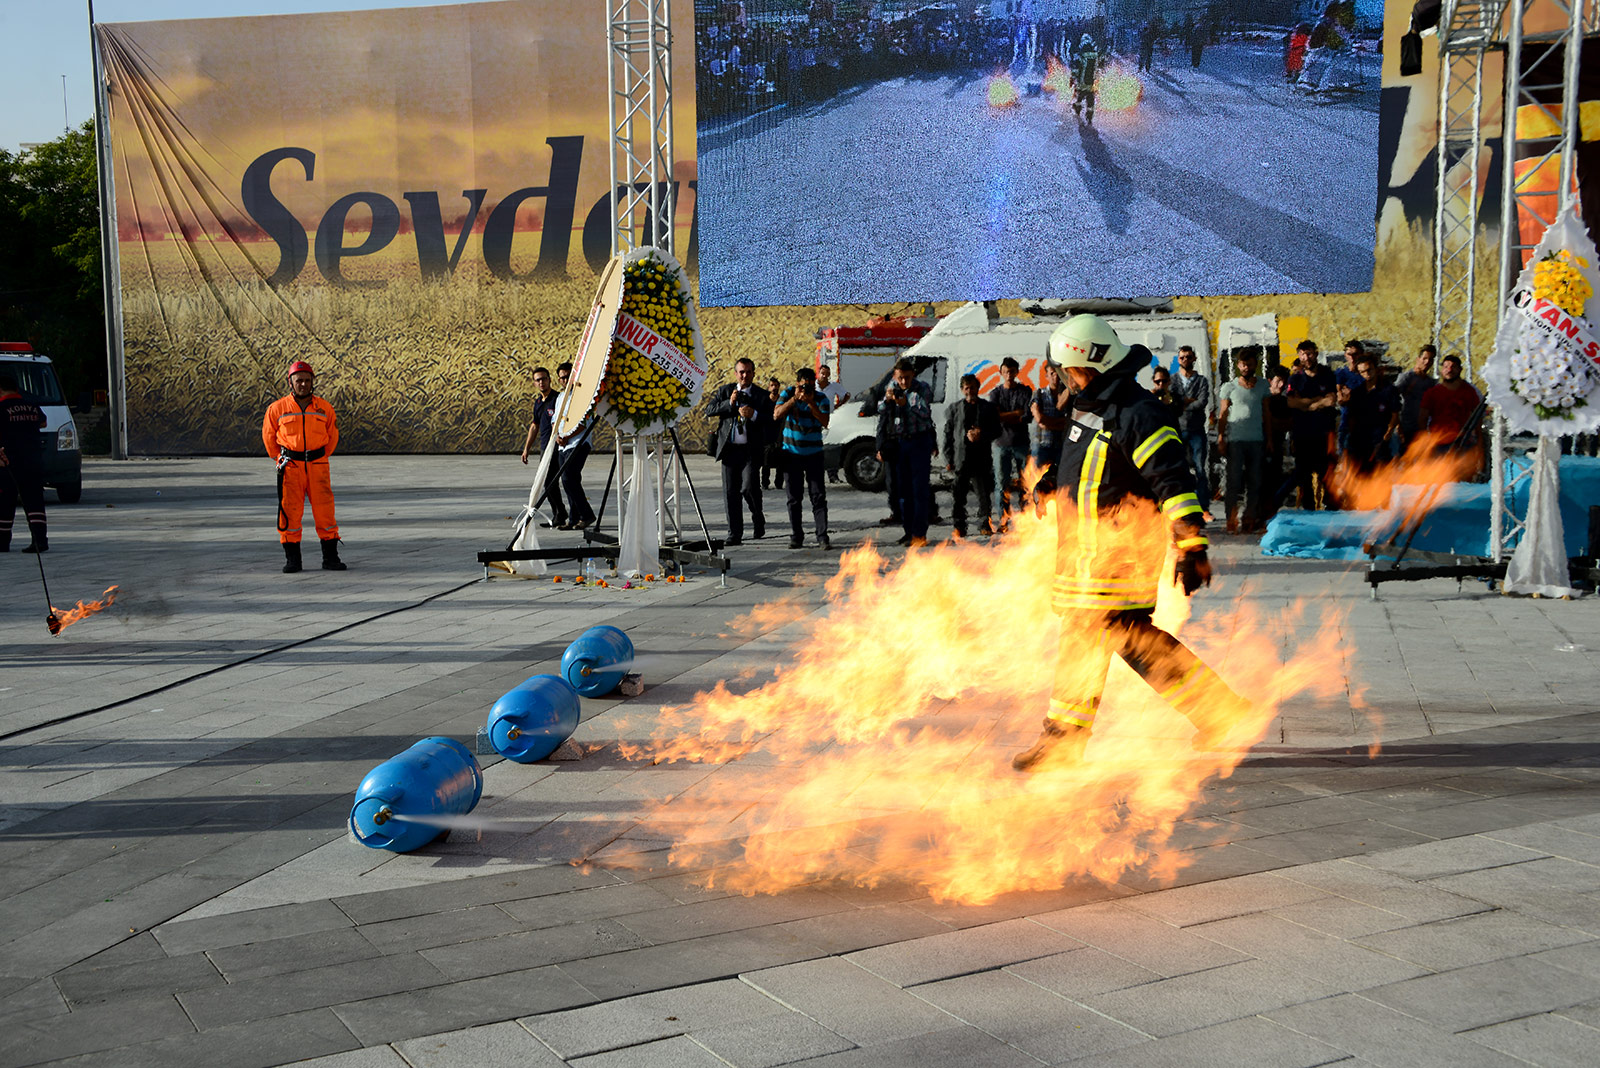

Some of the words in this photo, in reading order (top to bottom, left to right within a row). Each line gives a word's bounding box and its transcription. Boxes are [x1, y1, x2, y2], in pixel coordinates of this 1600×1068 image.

[241, 135, 698, 289] Sevda
[652, 353, 671, 370] 235
[671, 367, 684, 380] 53
[683, 377, 696, 390] 55
[6, 404, 39, 414] KONYA
